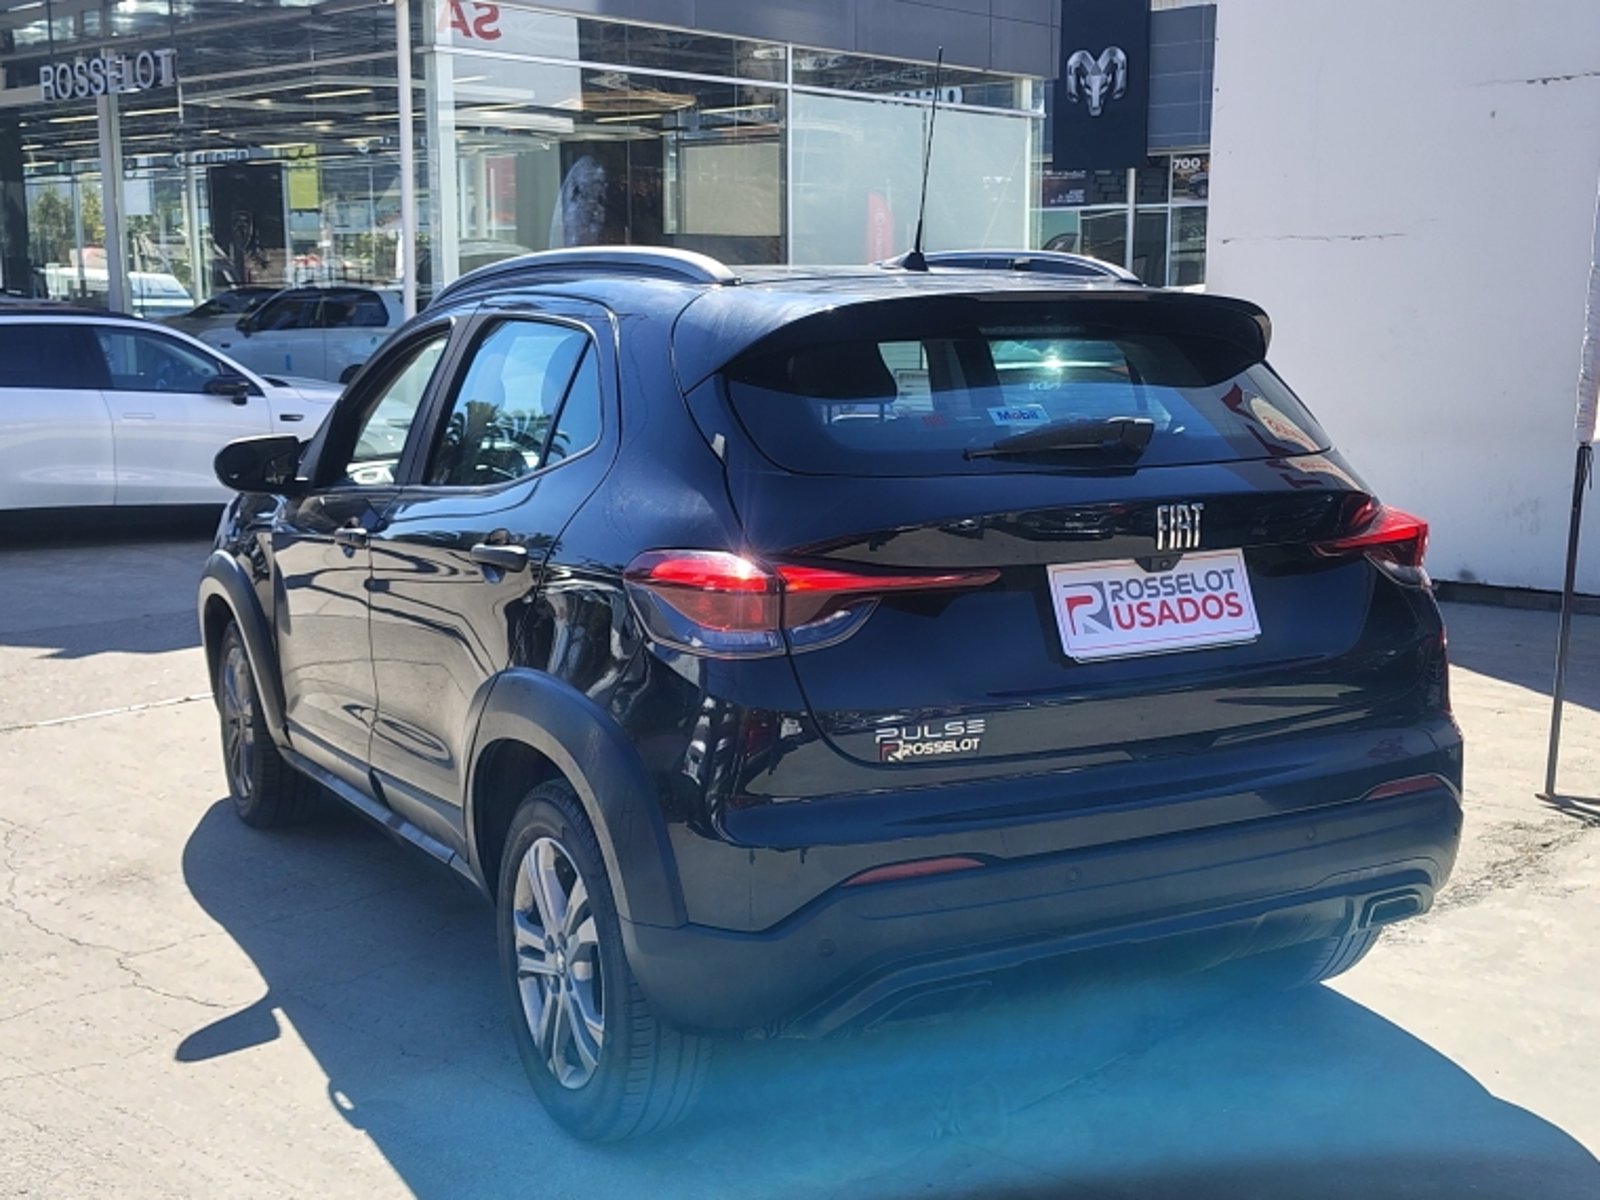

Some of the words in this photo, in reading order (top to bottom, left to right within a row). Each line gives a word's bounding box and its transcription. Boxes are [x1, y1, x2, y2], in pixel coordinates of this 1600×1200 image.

[39, 48, 178, 103] ROSSELOT
[1173, 157, 1201, 169] 700
[997, 410, 1040, 421] Mobil
[1157, 502, 1205, 550] FIAT
[1108, 568, 1235, 602] ROSSELOT
[1113, 591, 1244, 630] USADOS
[875, 719, 987, 745] PULSE
[903, 738, 980, 756] ROSSELOT
